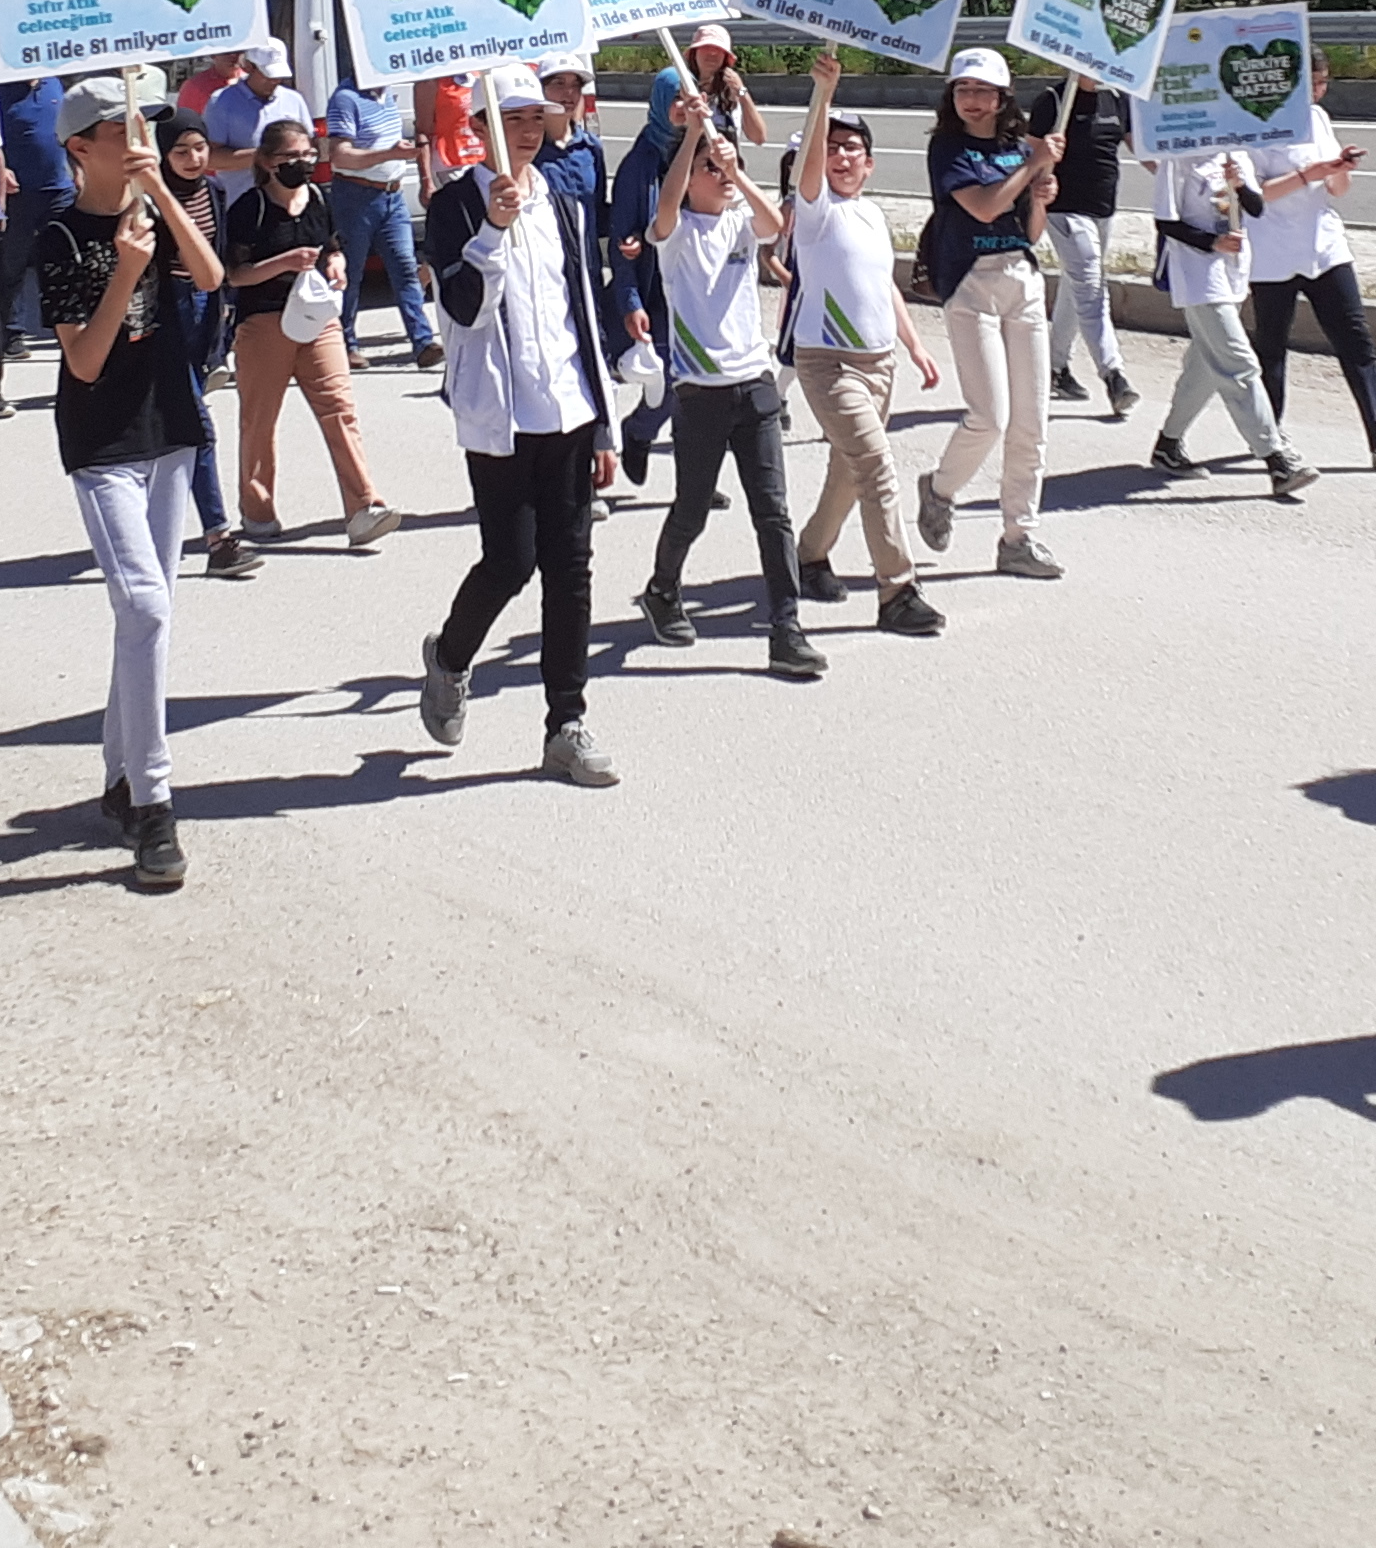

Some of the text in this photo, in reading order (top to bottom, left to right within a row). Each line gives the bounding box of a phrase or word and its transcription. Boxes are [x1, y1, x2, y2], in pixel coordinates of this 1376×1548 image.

[18, 11, 113, 34] Geleceğimiz
[390, 5, 454, 26] Sıfır Atık
[600, 10, 628, 27] ilde
[631, 7, 643, 20] 81
[646, 1, 686, 18] milyar
[383, 20, 468, 42] Geleceğimiz
[775, 0, 805, 21] ilde
[807, 11, 824, 26] 81
[826, 18, 878, 41] milyar
[880, 34, 921, 55] adım
[22, 22, 232, 63] 81 ilde 81 milyar adım
[389, 29, 569, 69] 81 ilde 81 milyar adım
[1230, 54, 1291, 72] TÜRKİYE
